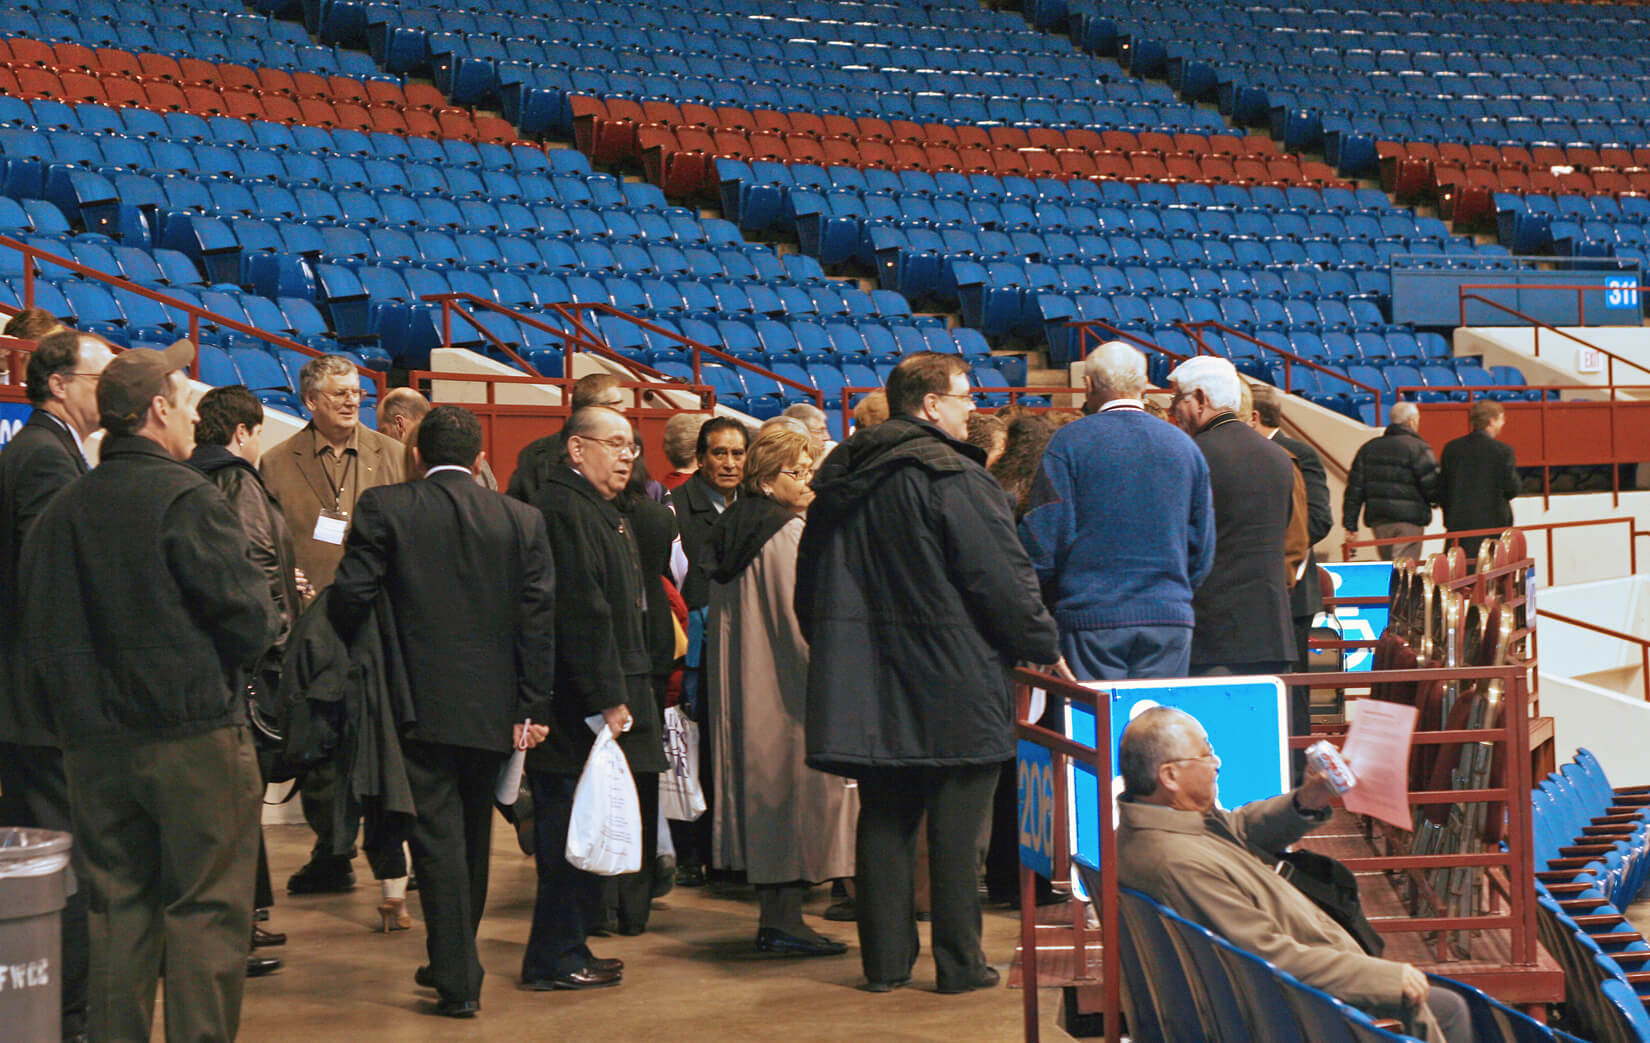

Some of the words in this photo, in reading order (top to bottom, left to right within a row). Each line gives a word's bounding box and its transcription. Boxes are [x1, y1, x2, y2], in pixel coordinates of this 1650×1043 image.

[1609, 281, 1637, 305] 311
[1585, 351, 1601, 368] EXIT
[1018, 759, 1054, 857] 206
